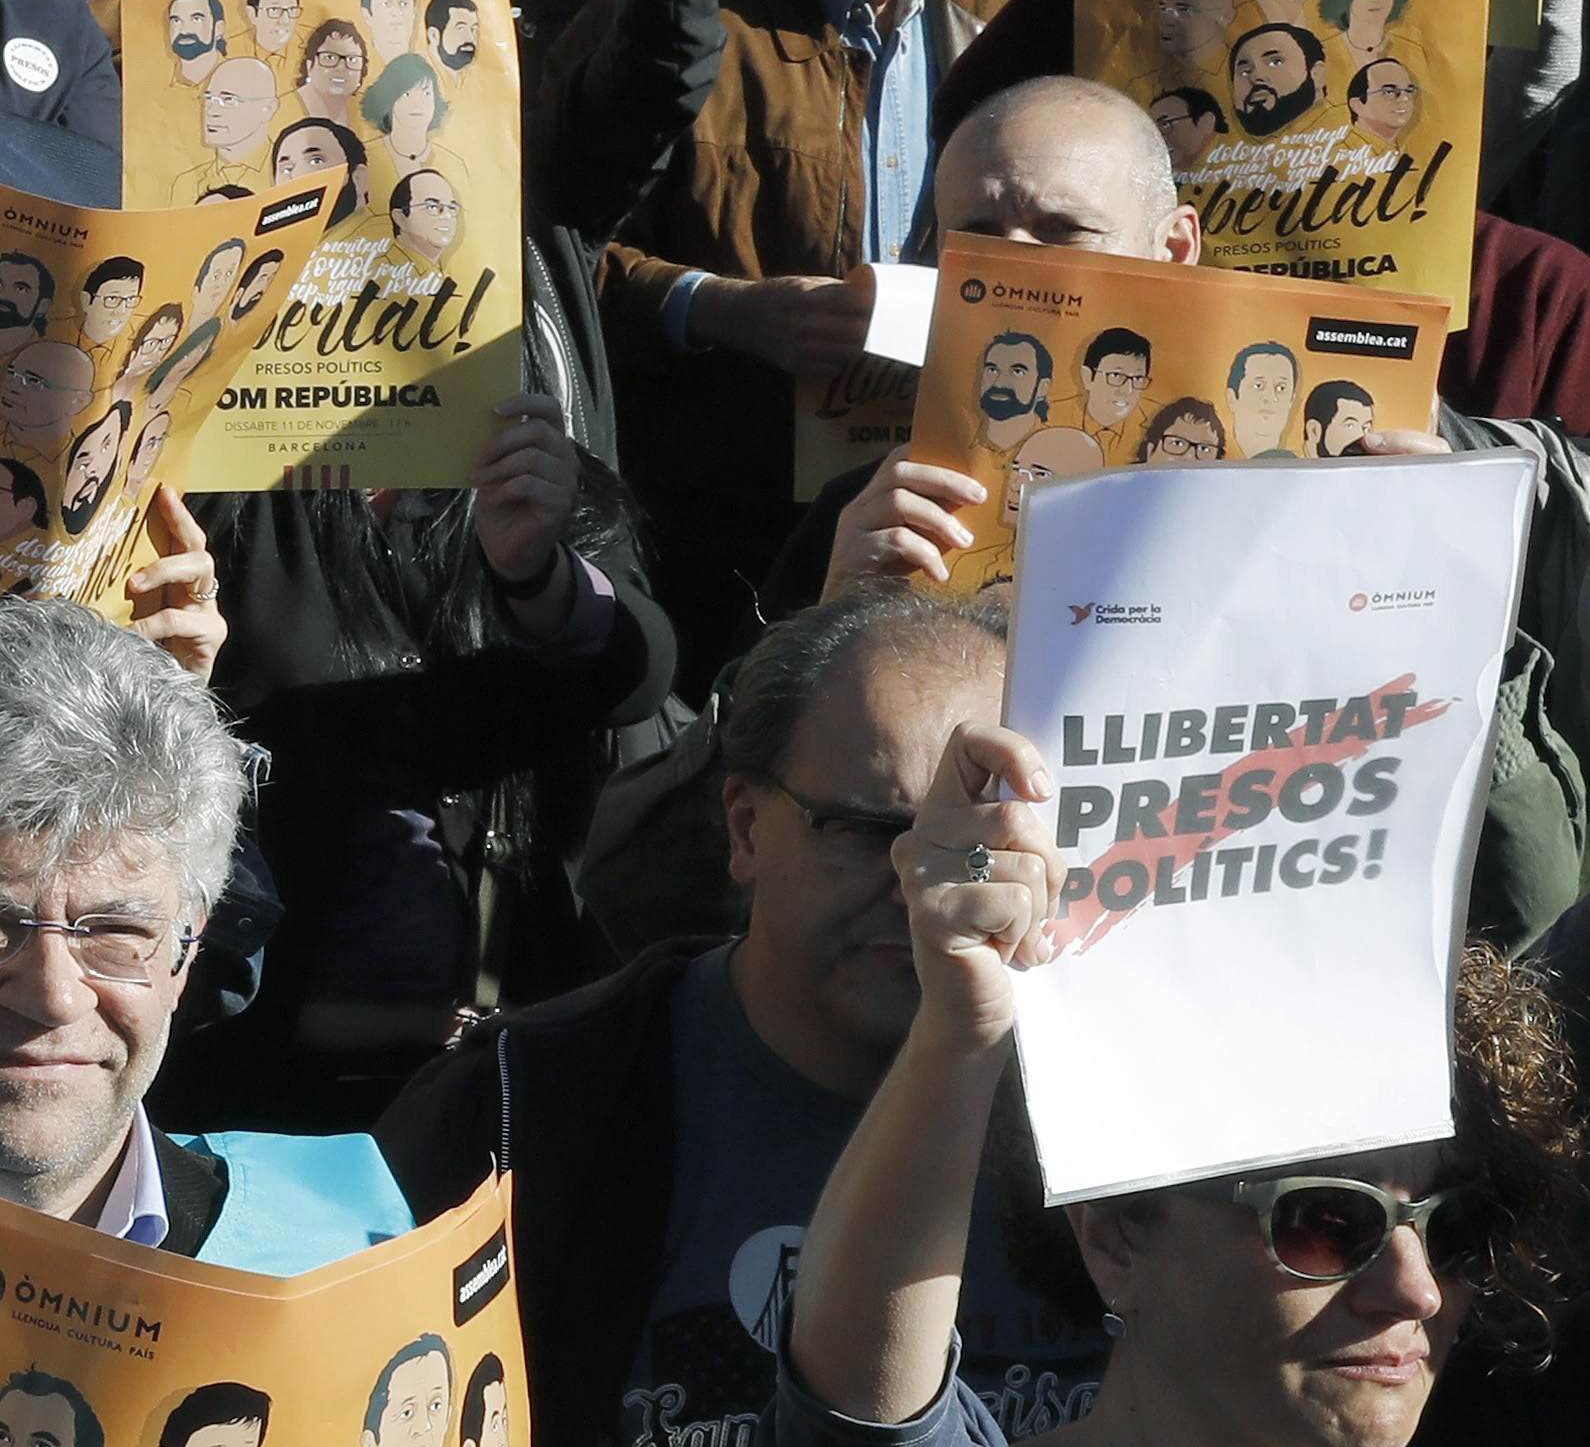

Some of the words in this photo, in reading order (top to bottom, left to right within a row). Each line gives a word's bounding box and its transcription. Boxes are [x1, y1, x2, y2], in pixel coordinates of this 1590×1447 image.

[992, 283, 1082, 308] ÒMNIUM
[1315, 327, 1408, 349] assemblea.cat
[1096, 605, 1125, 614] Crida
[1129, 606, 1148, 615] per
[1151, 605, 1161, 614] la
[1372, 590, 1436, 604] ÒMNIUM
[1096, 615, 1162, 624] Democràcia
[1062, 692, 1418, 766] LLIBERTAT
[1056, 758, 1404, 848] PRESOS
[1056, 830, 1388, 921] POLÍTICS!
[457, 1247, 509, 1303] assemblea.cat
[14, 1269, 162, 1342] ÒMNIUM
